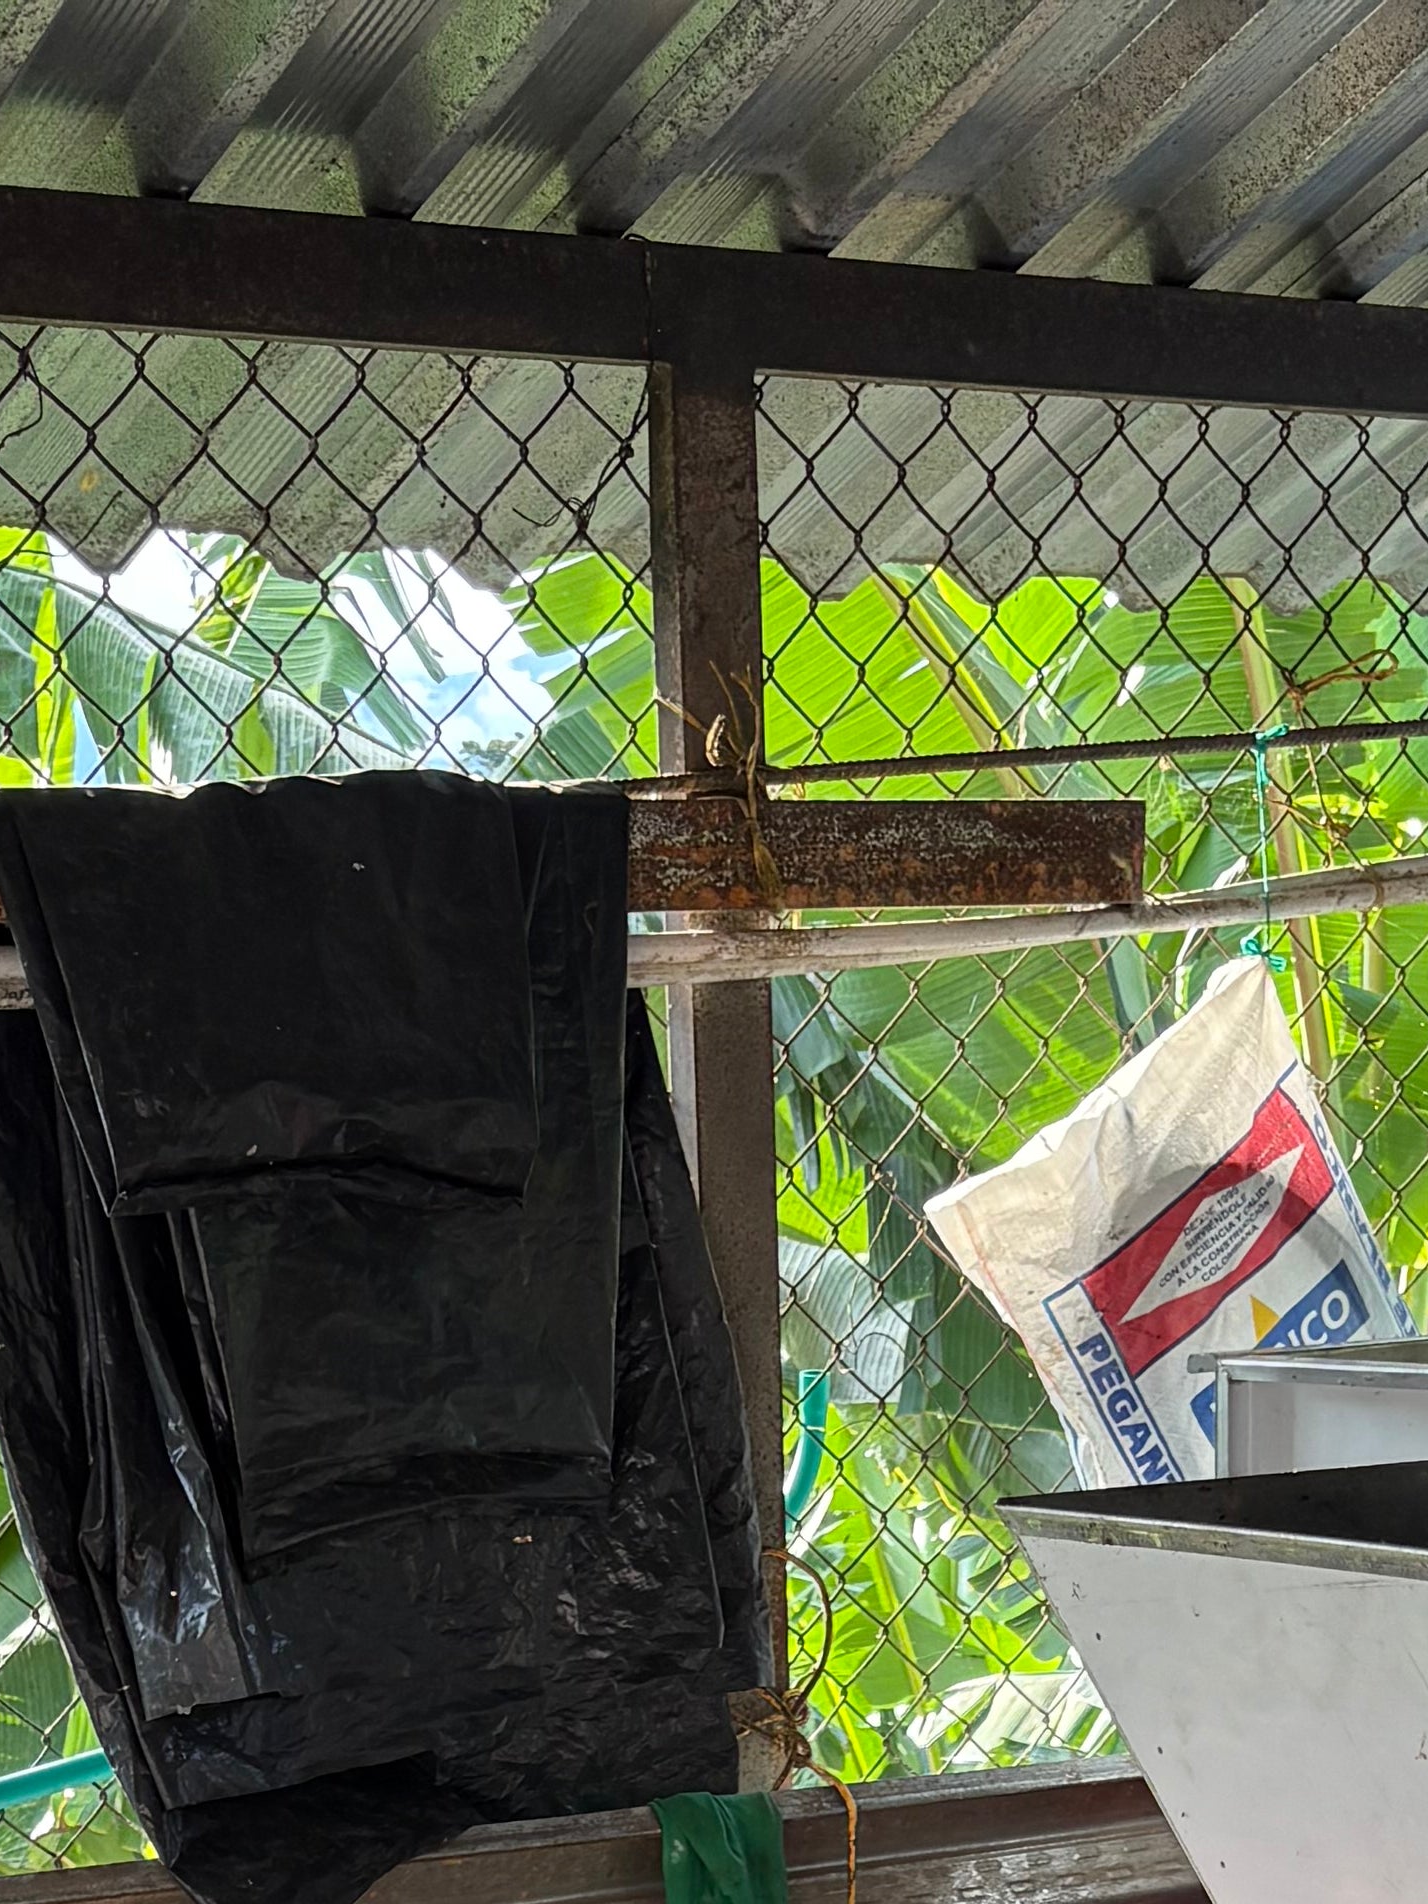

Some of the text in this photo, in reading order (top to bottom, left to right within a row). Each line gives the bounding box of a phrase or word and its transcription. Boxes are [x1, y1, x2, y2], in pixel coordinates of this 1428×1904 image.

[1159, 1265, 1180, 1288] CON
[1179, 1220, 1236, 1269] EFICIENCIA
[1186, 1265, 1202, 1280] LA
